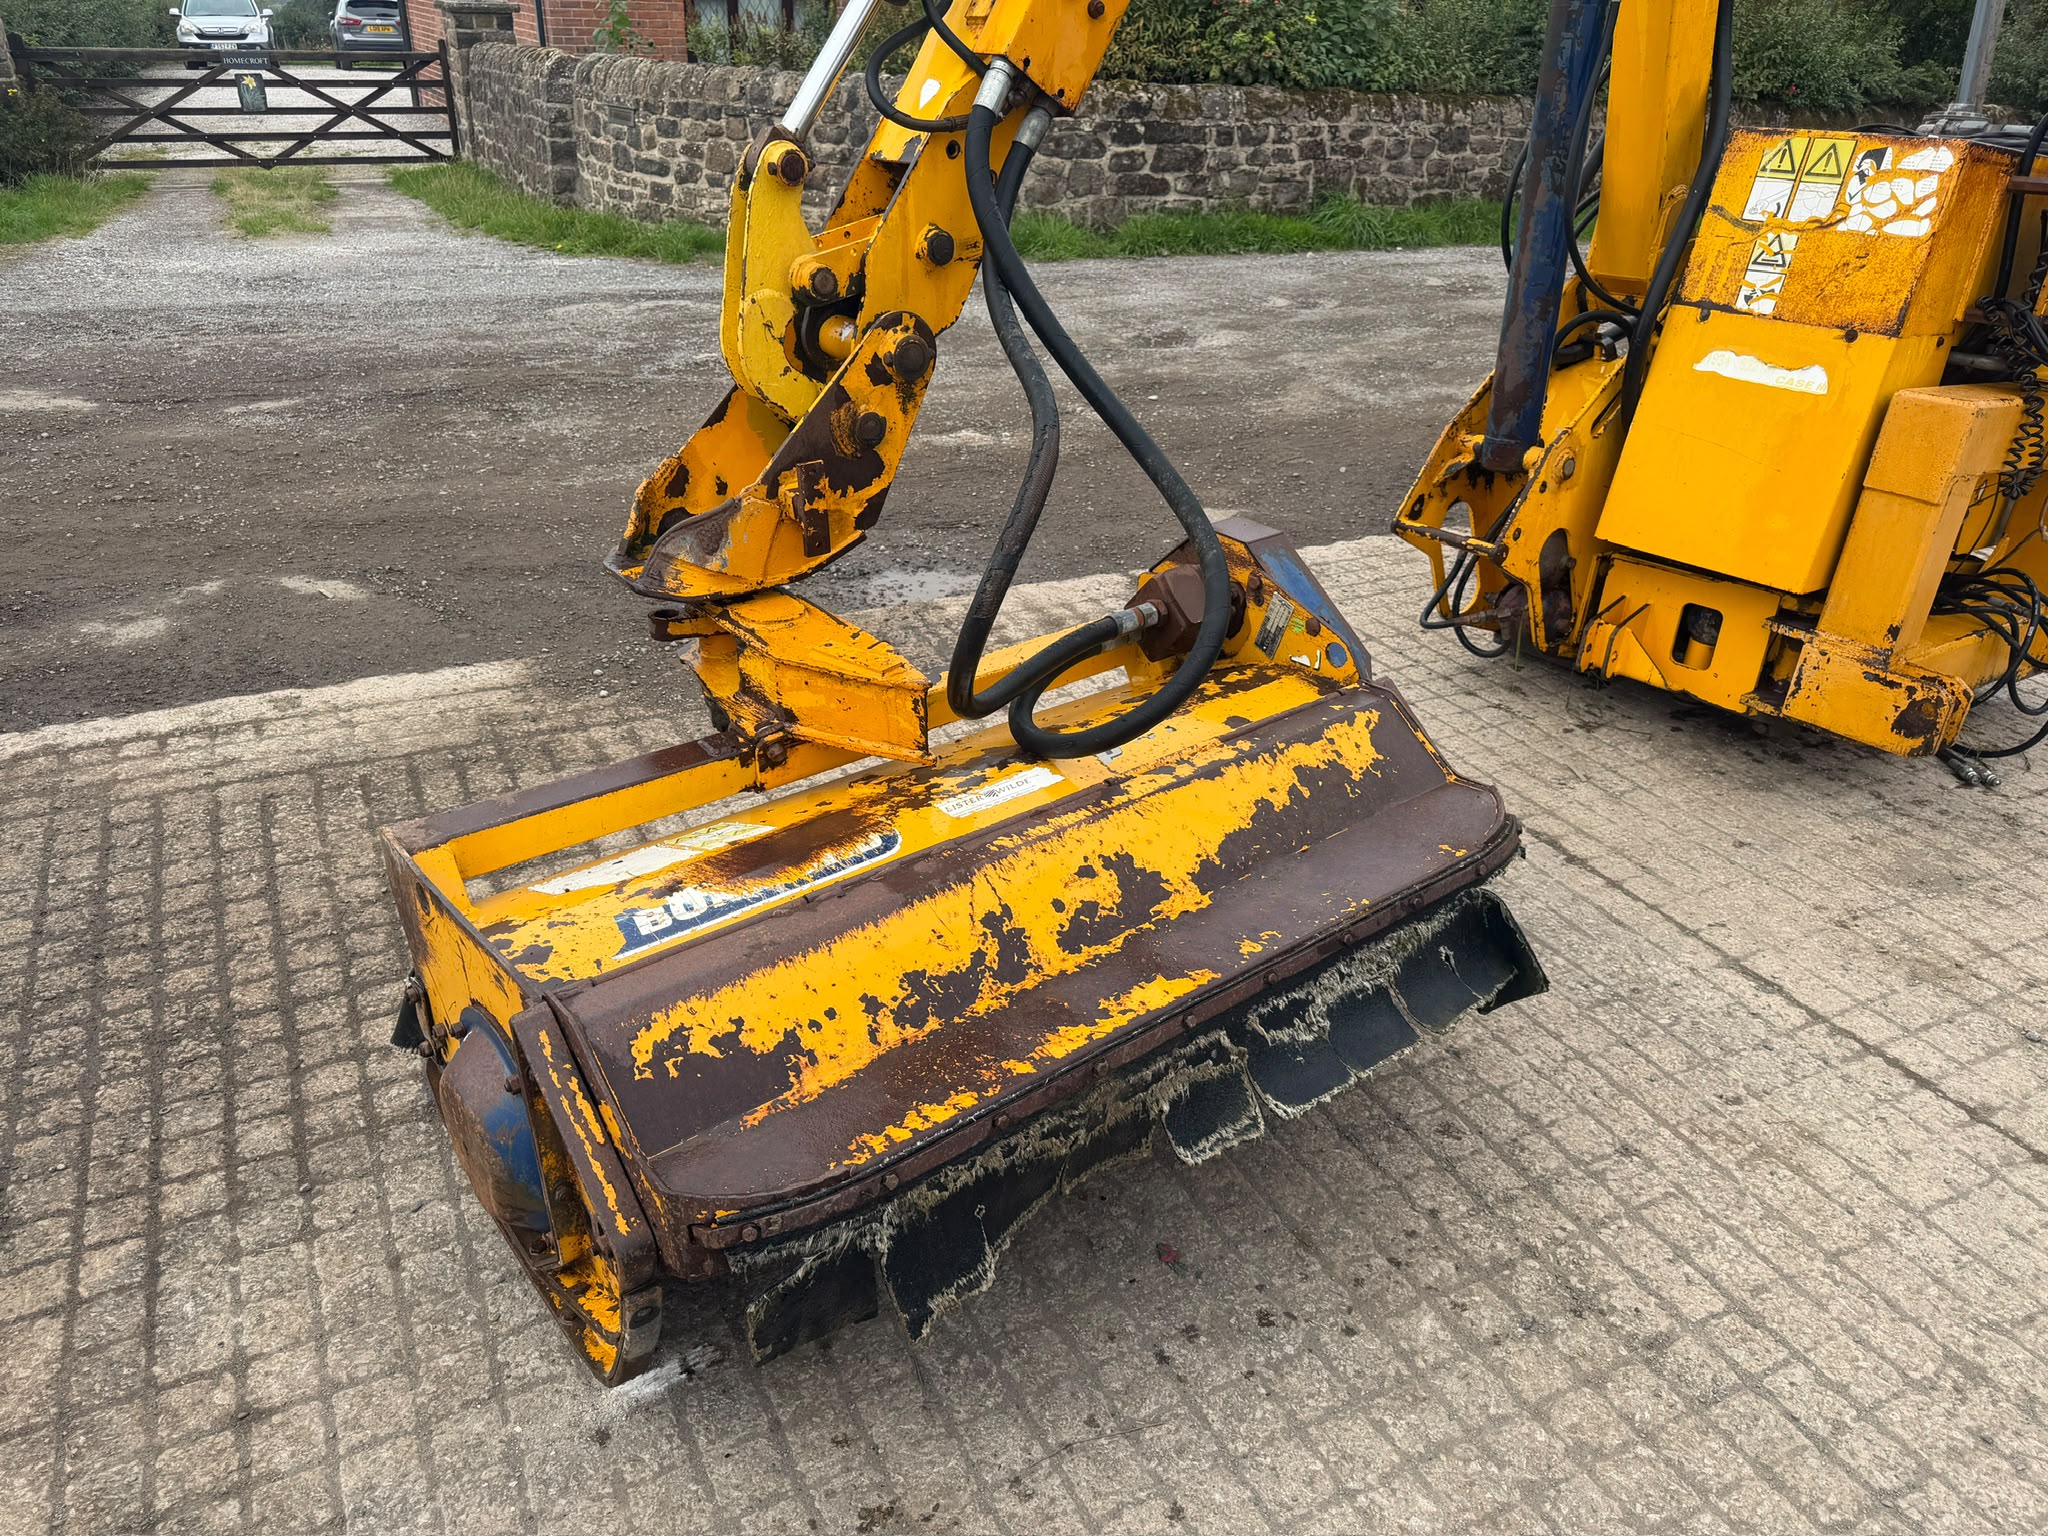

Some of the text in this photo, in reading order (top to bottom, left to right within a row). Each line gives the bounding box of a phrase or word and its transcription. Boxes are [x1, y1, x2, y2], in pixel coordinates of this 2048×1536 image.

[223, 57, 268, 65] HOMECROFT
[1775, 376, 1813, 390] CASE
[945, 795, 985, 813] LISTER
[996, 778, 1031, 794] WILDE
